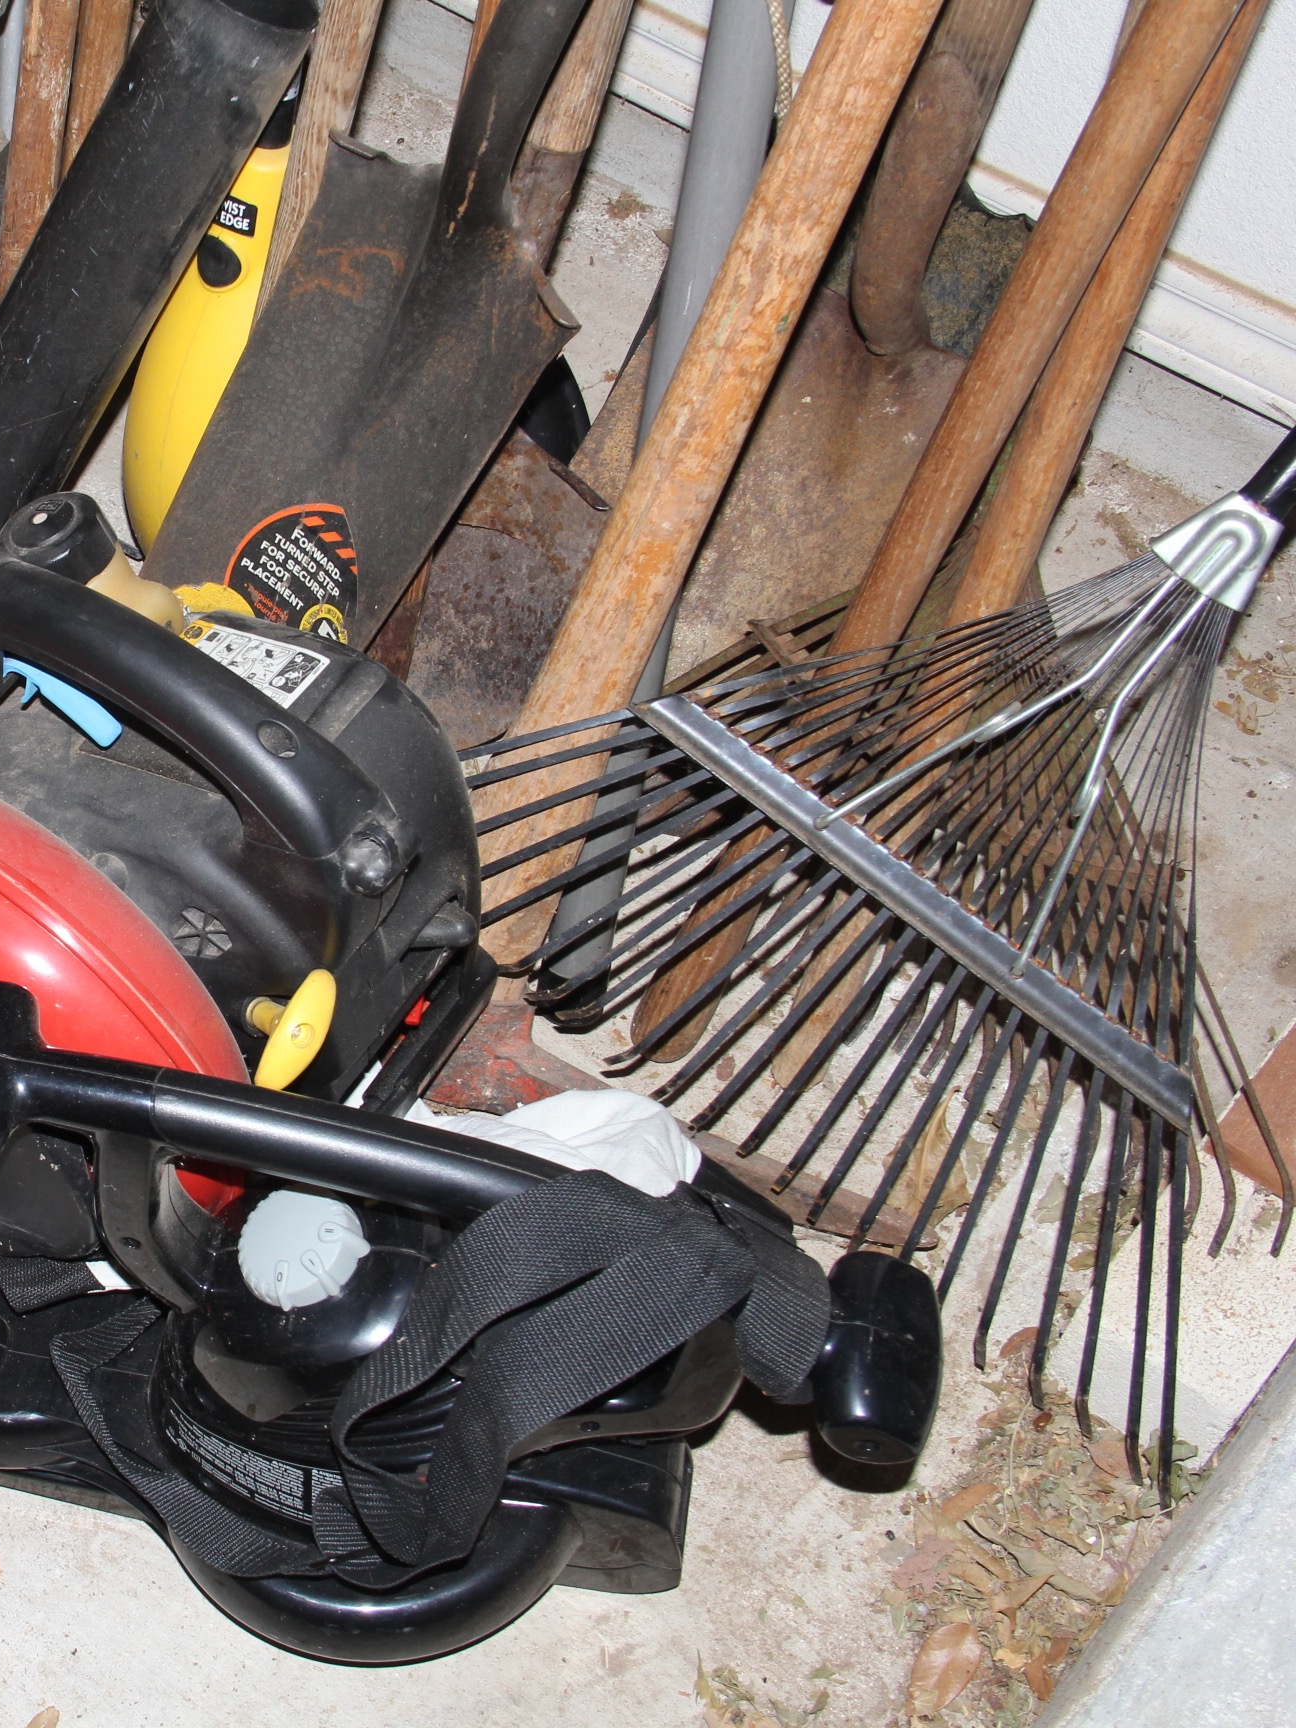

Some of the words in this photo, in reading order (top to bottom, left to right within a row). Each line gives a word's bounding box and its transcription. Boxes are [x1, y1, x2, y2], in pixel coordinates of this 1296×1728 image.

[219, 211, 250, 231] EDGE
[259, 555, 291, 582] FOOT
[260, 540, 284, 564] FOR
[286, 560, 326, 600] SECURE
[274, 533, 317, 573] TURNED
[317, 570, 340, 597] STEP
[291, 528, 343, 583] FORWARD-
[241, 557, 304, 611] PLACEMENT
